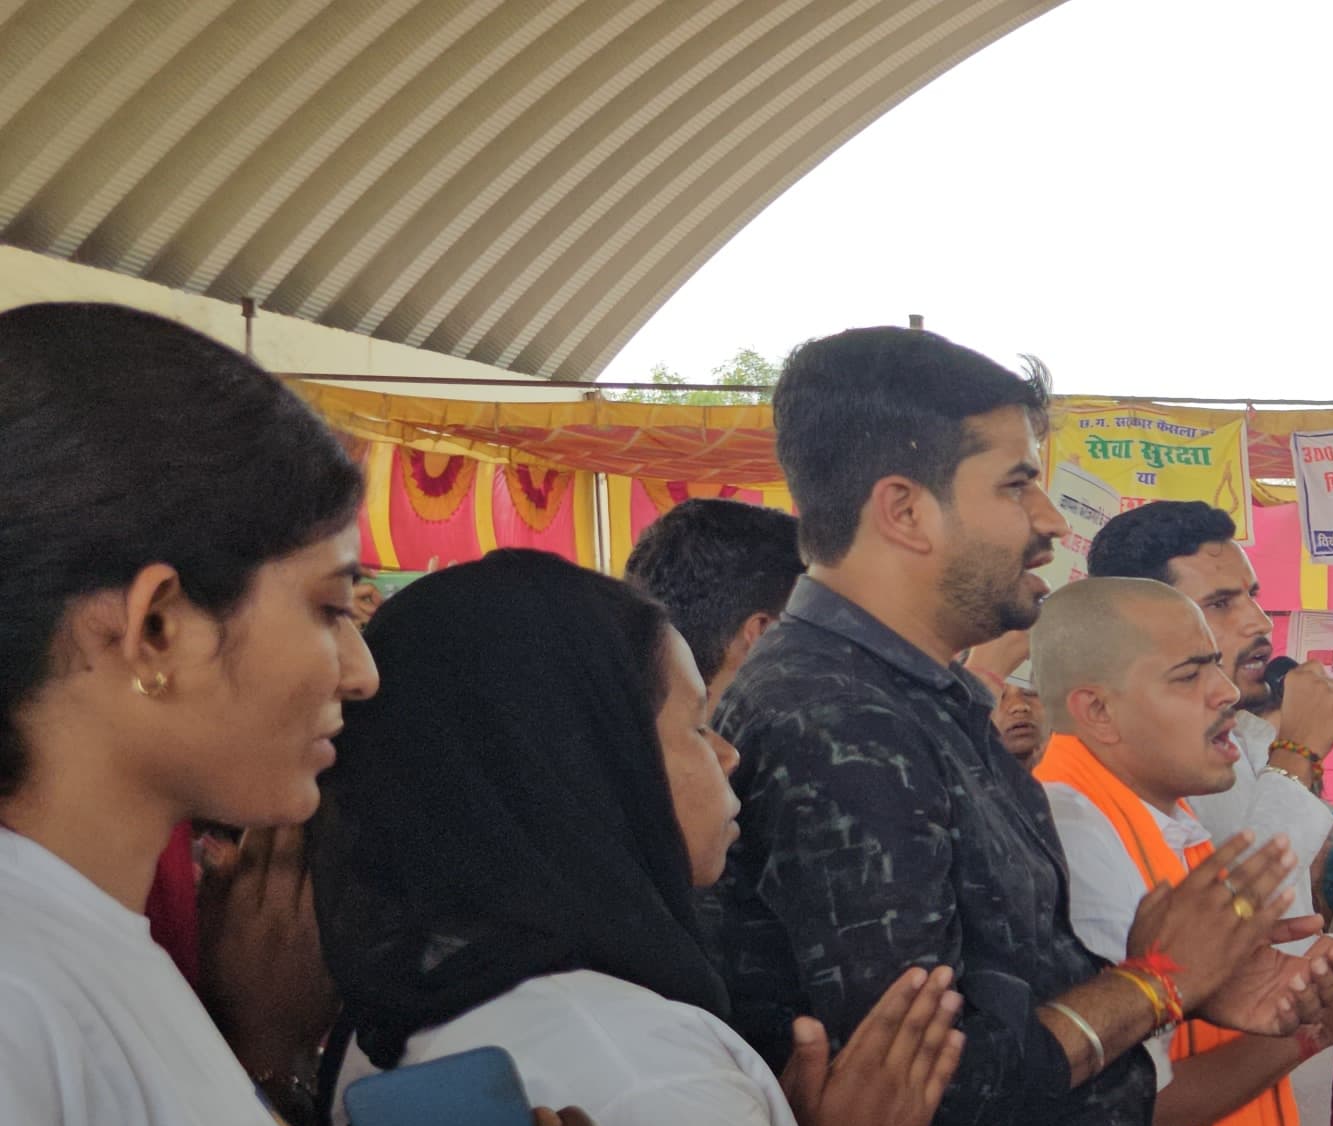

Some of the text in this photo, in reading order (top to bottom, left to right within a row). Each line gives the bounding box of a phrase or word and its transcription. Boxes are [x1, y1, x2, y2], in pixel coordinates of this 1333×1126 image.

[1084, 434, 1213, 469] सेवा सुरक्षा
[1135, 472, 1157, 485] या
